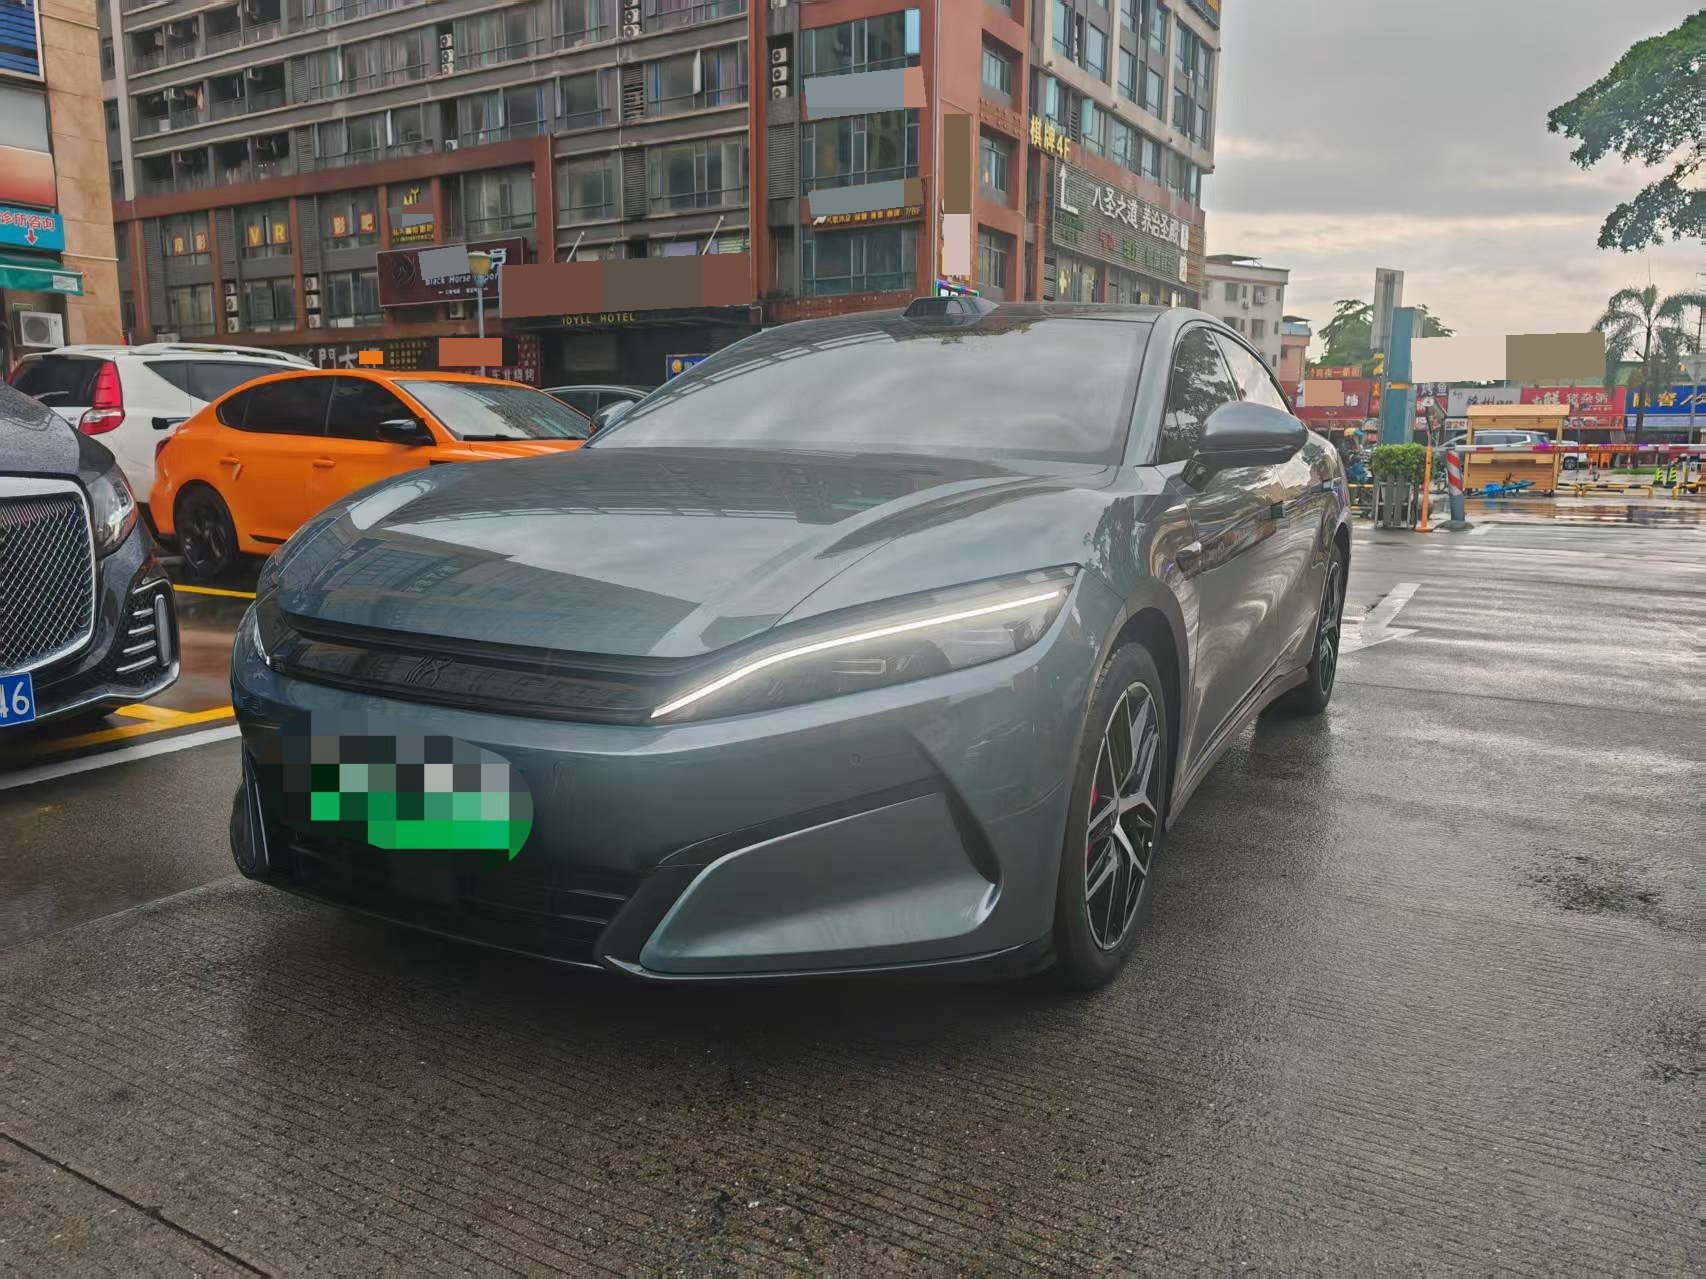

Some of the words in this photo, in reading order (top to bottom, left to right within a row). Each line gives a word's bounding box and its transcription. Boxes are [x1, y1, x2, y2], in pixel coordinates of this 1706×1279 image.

[1029, 115, 1072, 160] 棋牌4F
[562, 316, 592, 327] IDYLL
[600, 311, 636, 324] HOTEL
